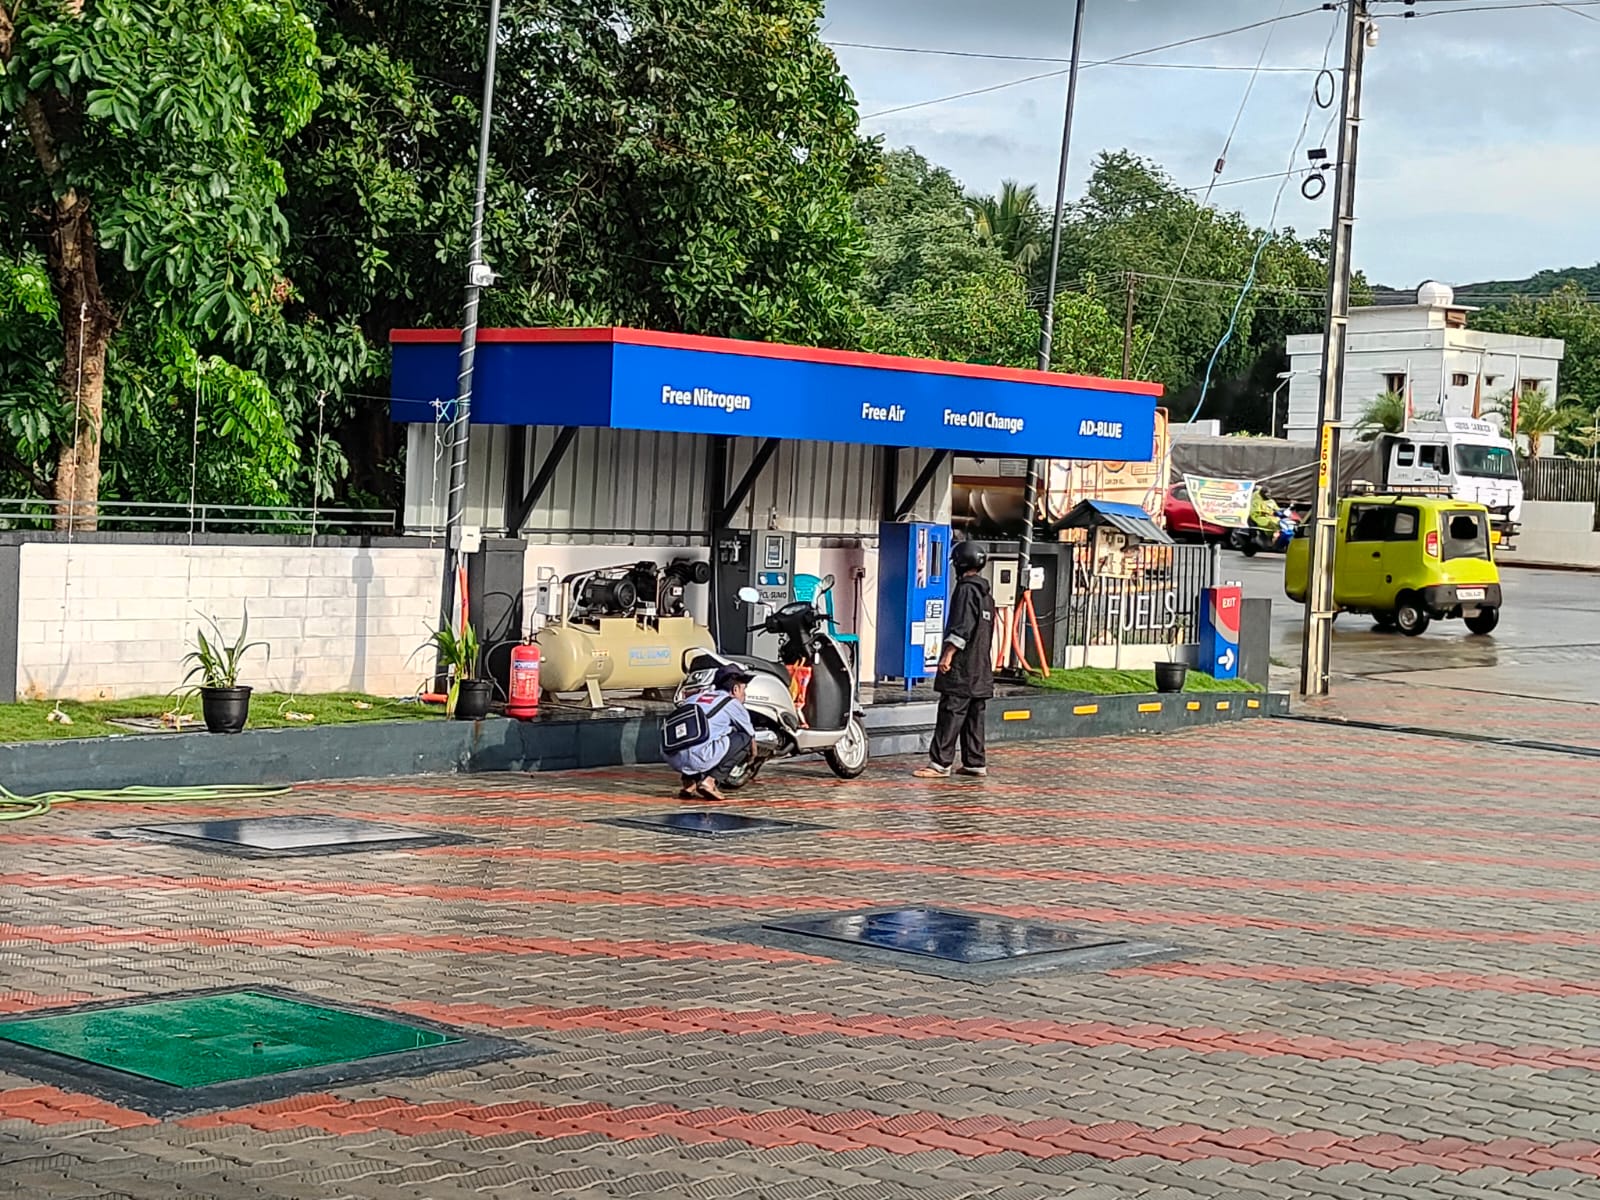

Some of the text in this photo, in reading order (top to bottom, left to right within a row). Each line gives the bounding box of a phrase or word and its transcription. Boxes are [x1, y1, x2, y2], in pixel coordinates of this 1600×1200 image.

[662, 385, 751, 413] Free Nitrogen
[862, 402, 906, 422] Free Air
[944, 408, 1024, 434] Free Oil Change
[1078, 419, 1123, 439] AD-BLUE
[1107, 591, 1176, 631] FUELS
[1221, 596, 1237, 609] EXIT
